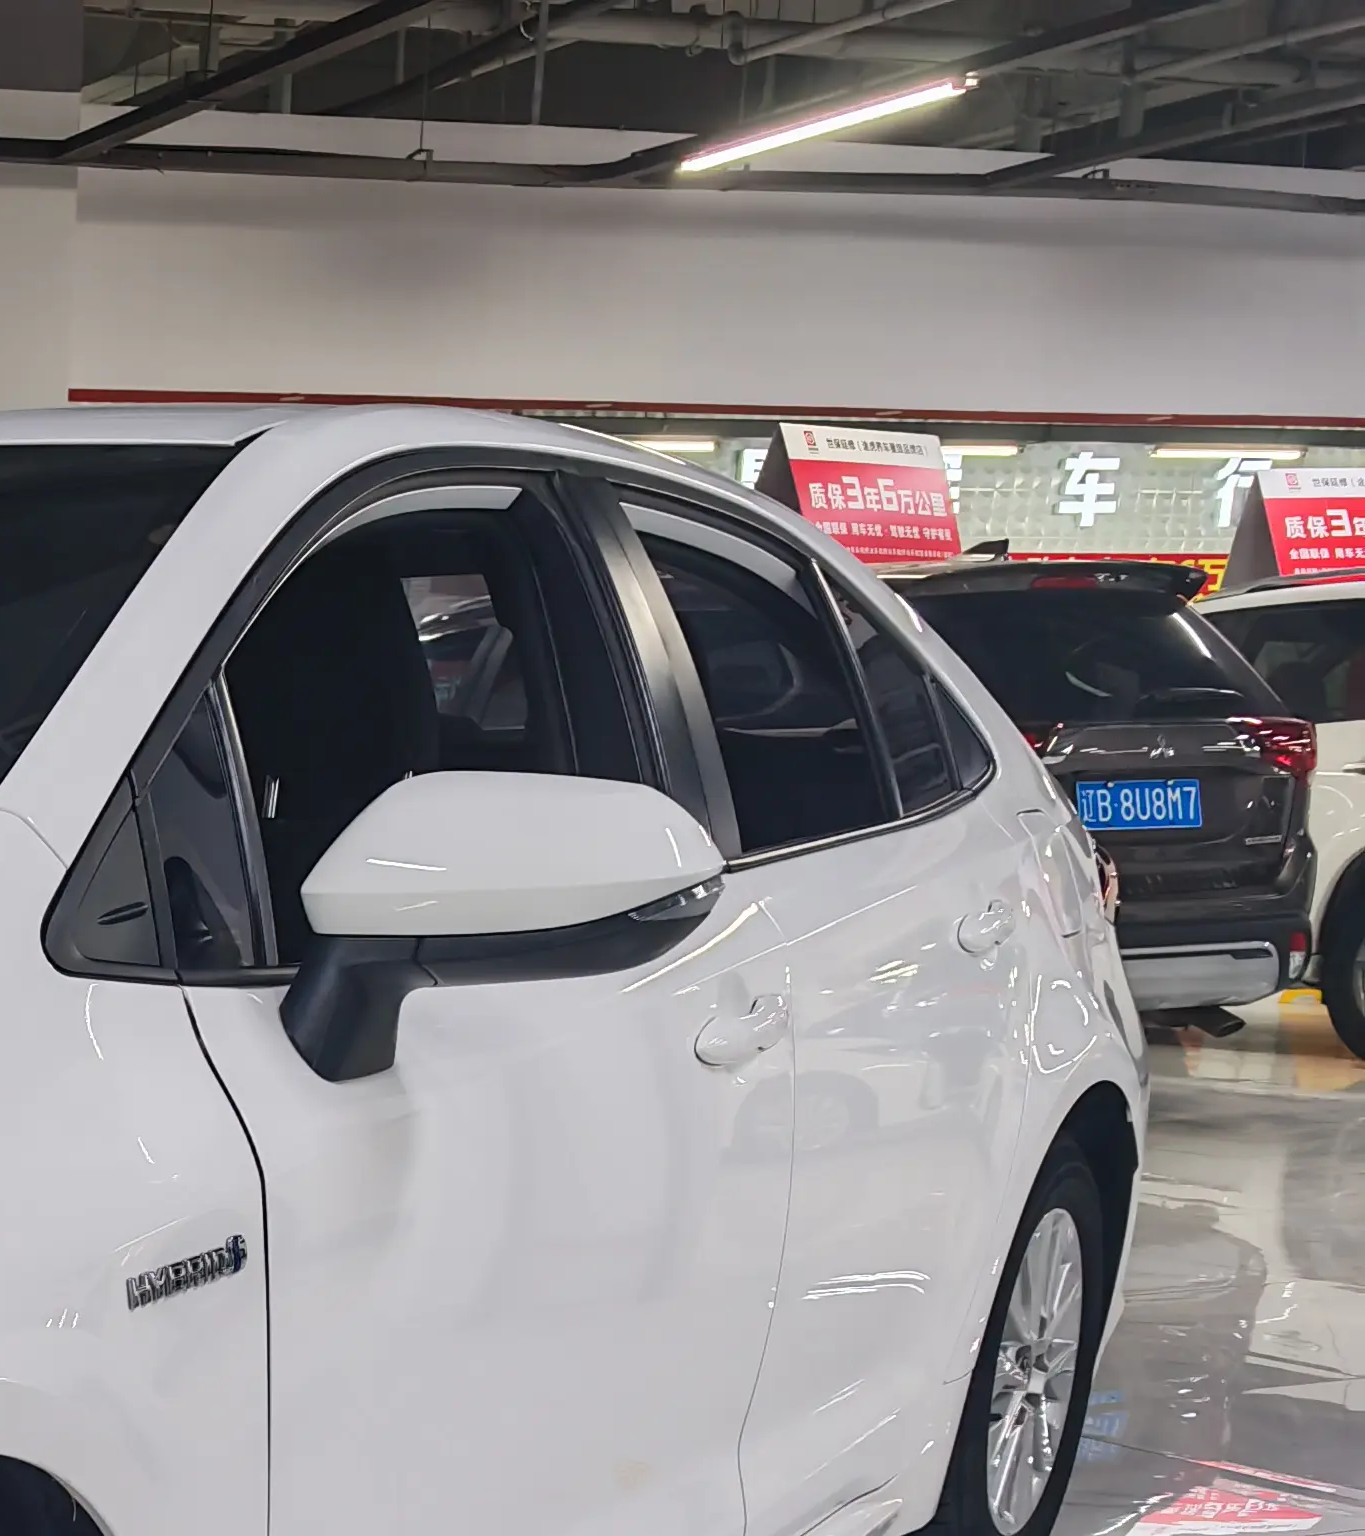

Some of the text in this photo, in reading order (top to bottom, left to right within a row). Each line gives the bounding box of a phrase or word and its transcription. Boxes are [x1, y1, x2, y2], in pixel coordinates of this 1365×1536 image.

[808, 475, 948, 517] 质保3年6万公里
[1058, 451, 1121, 528] 车
